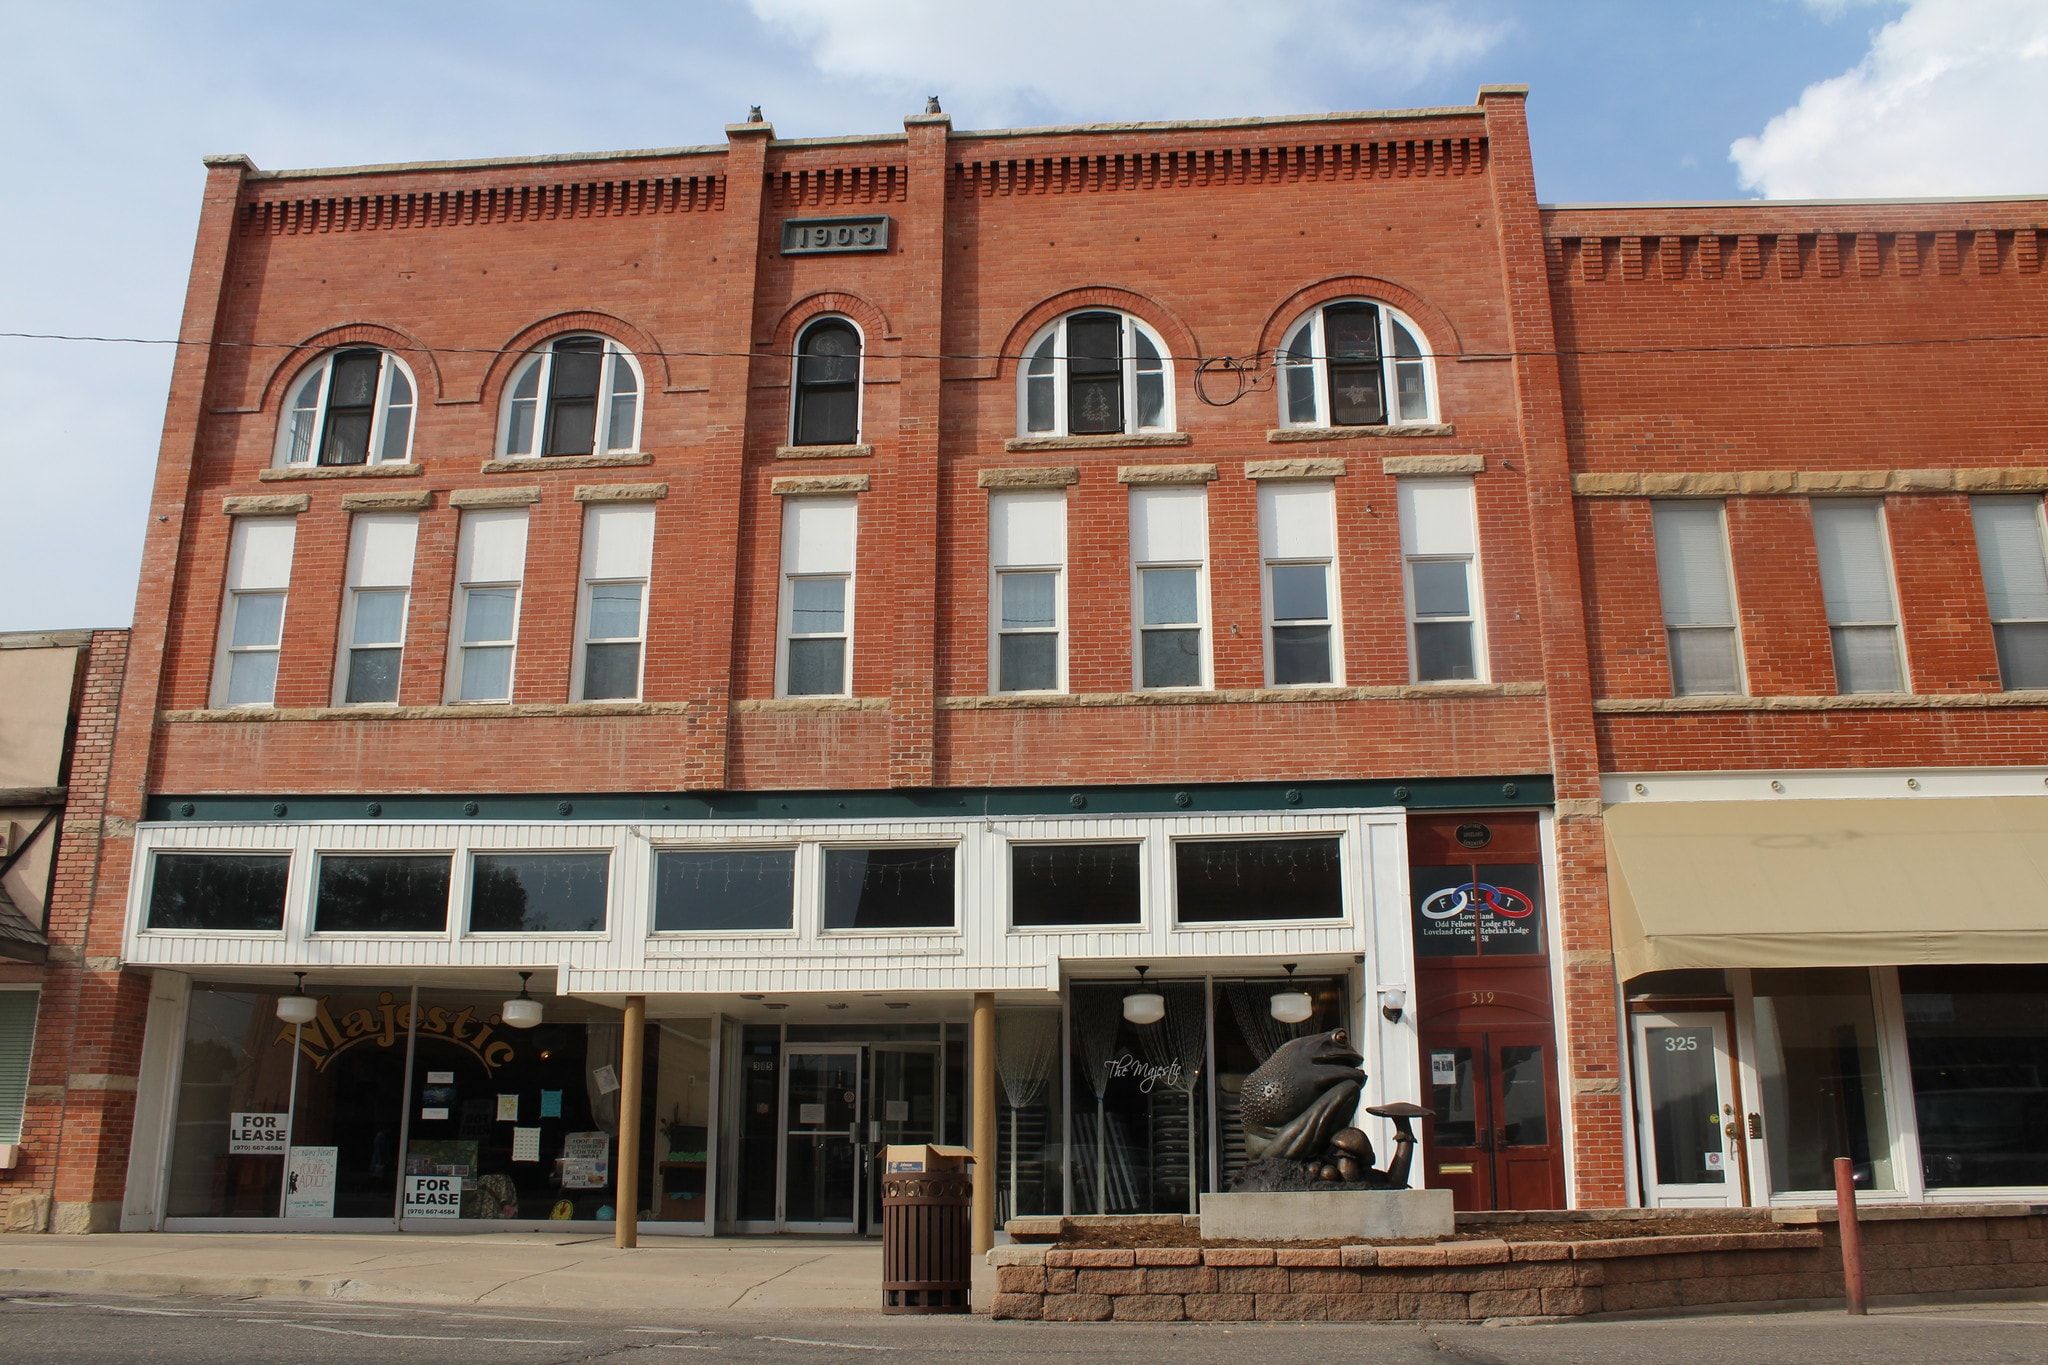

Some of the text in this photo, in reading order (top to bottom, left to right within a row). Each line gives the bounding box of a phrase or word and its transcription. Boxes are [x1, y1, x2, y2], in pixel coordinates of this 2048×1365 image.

[799, 226, 873, 247] 1903
[1439, 898, 1447, 908] F
[1506, 897, 1514, 907] T
[1482, 920, 1501, 928] Lodge
[1510, 927, 1530, 935] Lodge
[1472, 992, 1494, 1005] 319
[273, 991, 515, 1069] Majestic
[1665, 1036, 1697, 1052] 325
[1104, 1054, 1182, 1094] The Majestic
[242, 1116, 276, 1128] FOR
[232, 1130, 286, 1141] LEASE
[234, 1144, 251, 1152] (970)
[417, 1180, 450, 1191] FOR
[406, 1193, 459, 1205] LEASE
[408, 1208, 424, 1216] (970)
